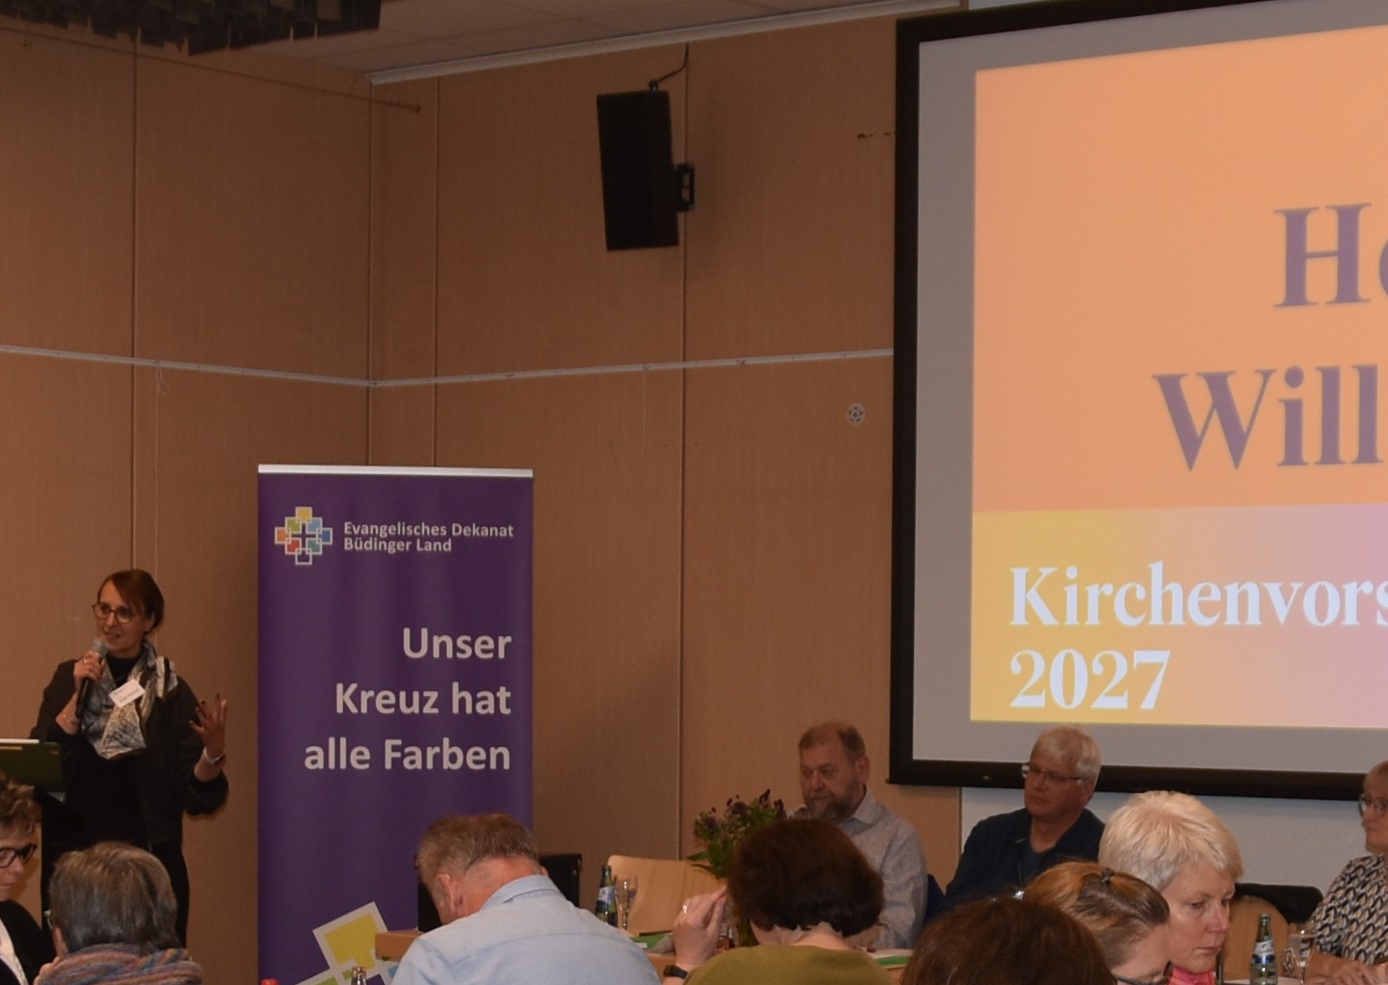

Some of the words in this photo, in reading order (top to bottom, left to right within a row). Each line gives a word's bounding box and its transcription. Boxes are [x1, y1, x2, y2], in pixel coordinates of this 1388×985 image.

[344, 521, 447, 537] Evangelisches
[452, 523, 514, 537] Dekanat
[344, 537, 412, 553] Büdinger
[416, 538, 452, 552] Land
[403, 627, 513, 659] Unser
[1009, 647, 1172, 711] 2027
[335, 682, 439, 714] Kreuz
[451, 681, 512, 715] hat
[304, 736, 371, 770] alle
[384, 737, 511, 770] Farben
